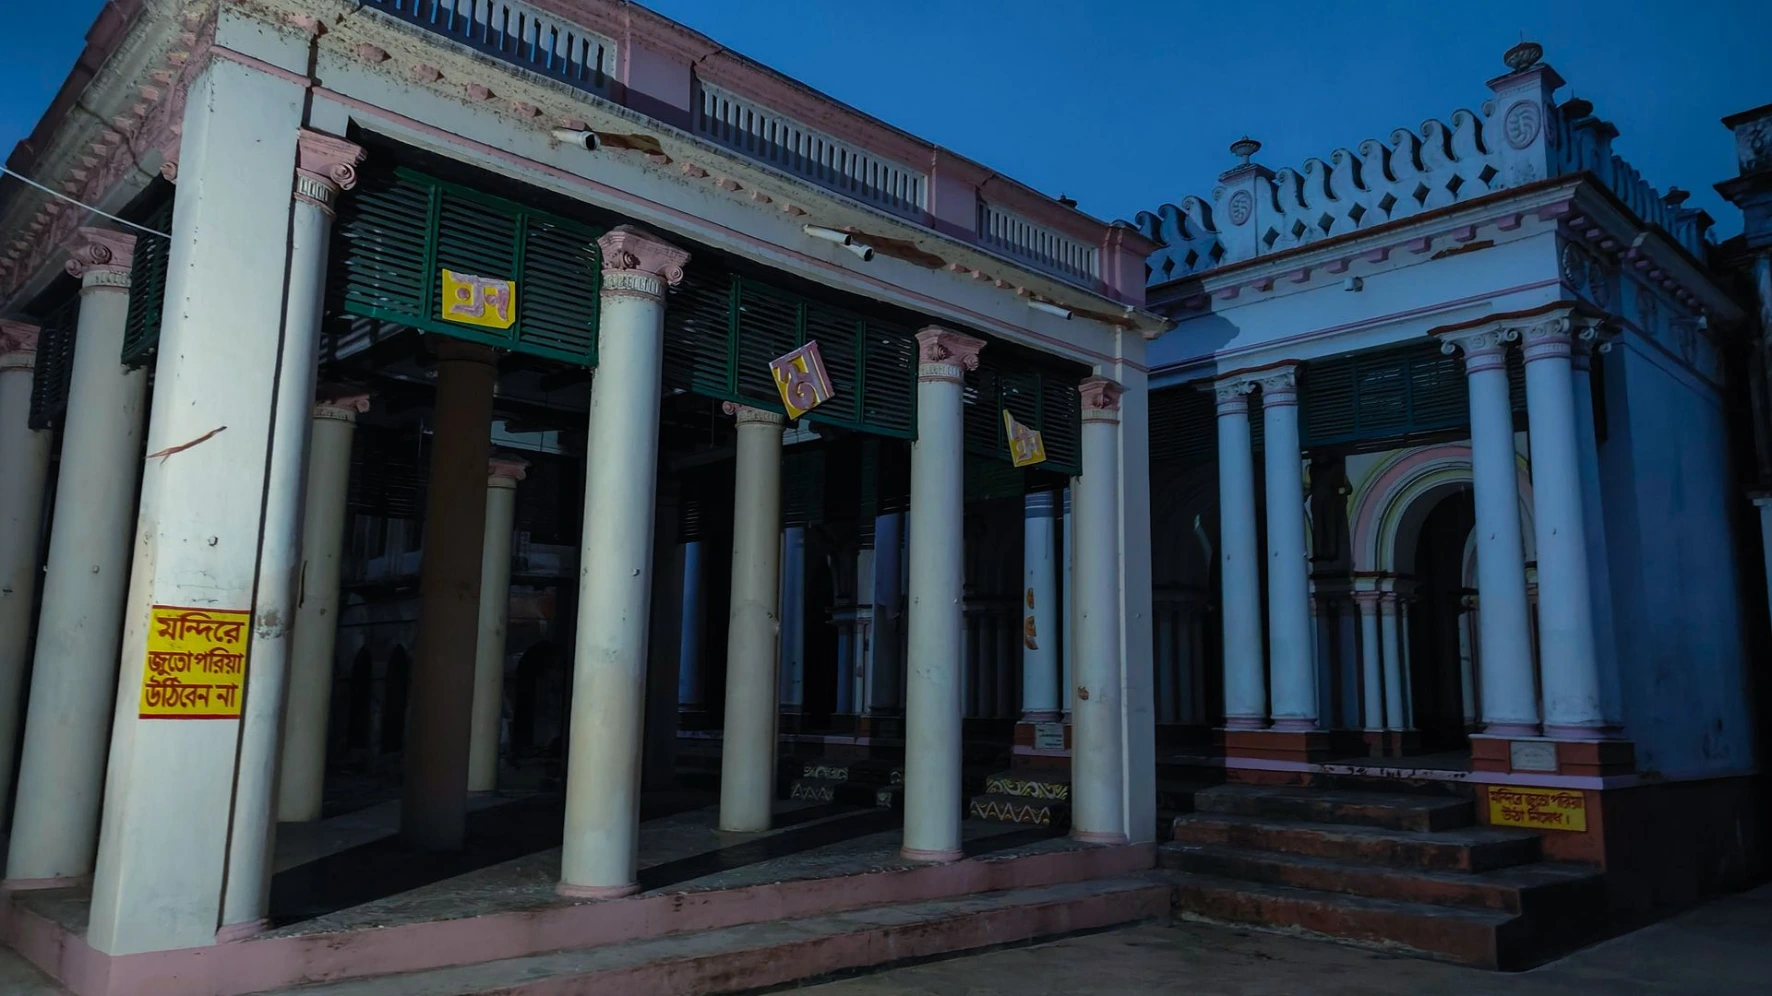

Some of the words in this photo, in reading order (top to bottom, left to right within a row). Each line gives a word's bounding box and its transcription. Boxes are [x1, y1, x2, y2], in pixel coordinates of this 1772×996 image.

[156, 611, 246, 644] মন্দিরে
[145, 675, 213, 708] উঠিবেন
[215, 682, 239, 708] না
